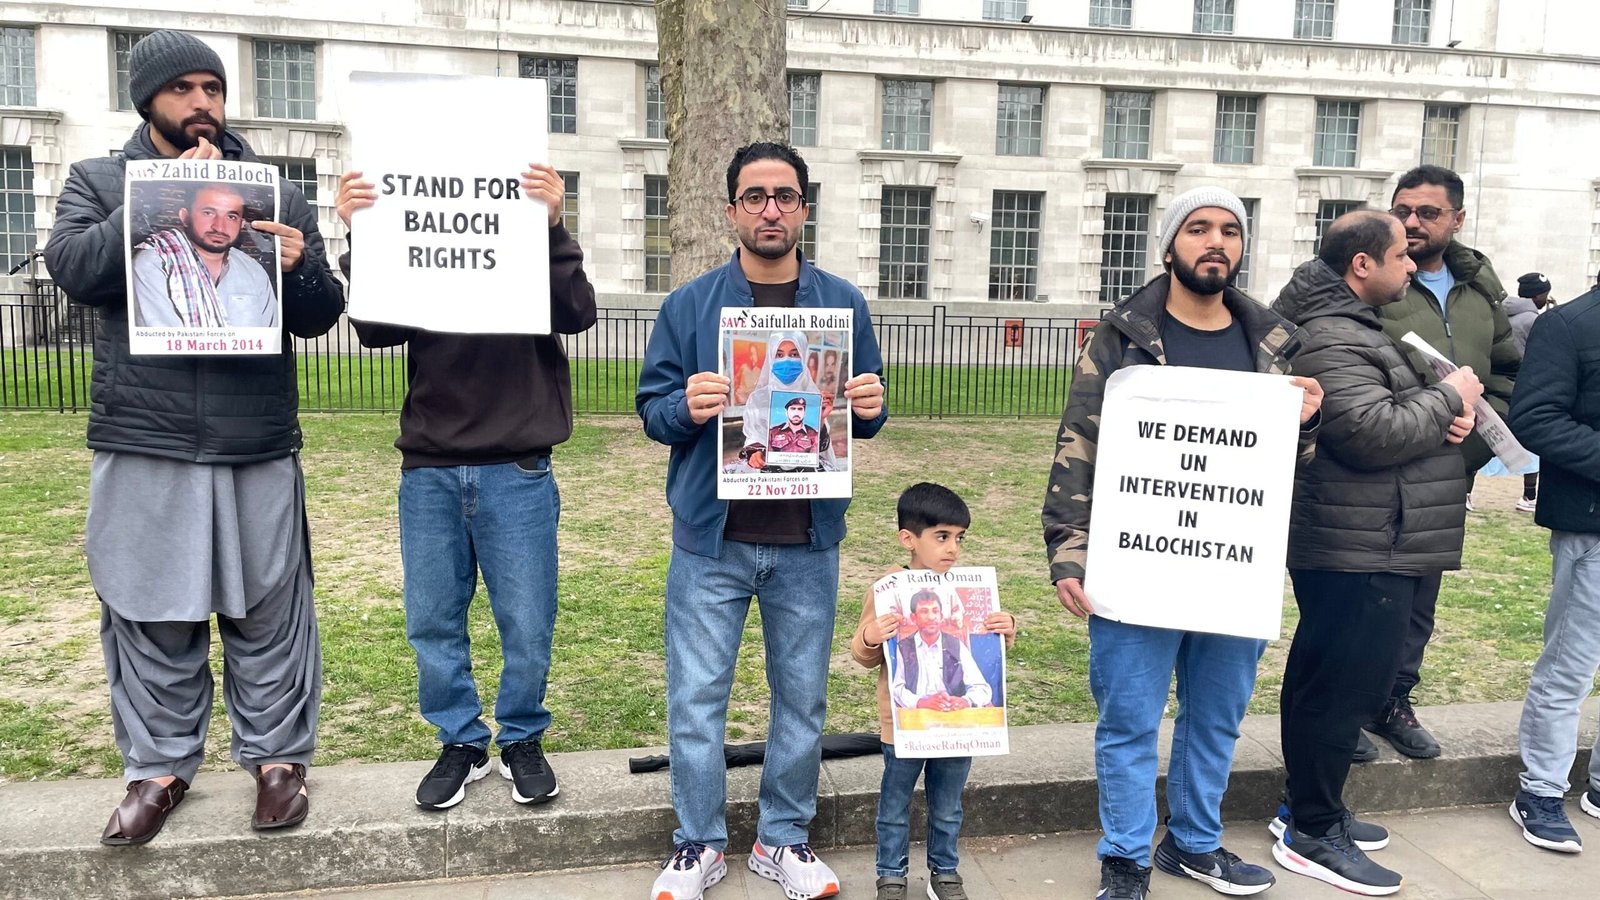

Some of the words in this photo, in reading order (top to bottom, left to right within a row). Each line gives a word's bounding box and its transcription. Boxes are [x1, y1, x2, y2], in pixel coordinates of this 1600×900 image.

[162, 162, 209, 179] Zahid
[216, 164, 273, 184] Baloch
[382, 173, 464, 198] STAND
[474, 178, 520, 200] FOR
[404, 210, 500, 235] BALOCH
[408, 246, 497, 270] RIGHTS
[750, 314, 806, 328] Saifullah
[811, 314, 850, 328] Rodini
[166, 339, 182, 351] 18
[187, 339, 228, 350] March
[231, 339, 264, 350] 2014
[1138, 420, 1167, 440] WE
[1174, 424, 1258, 448] DEMAND
[1180, 454, 1208, 472] UN
[748, 484, 762, 496] 22
[766, 484, 787, 496] Nov
[790, 484, 818, 496] 2013
[1119, 475, 1264, 507] INTERVENTION
[1178, 510, 1198, 528] IN
[1118, 532, 1254, 564] BALOCHISTAN
[907, 572, 941, 585] Rafiq
[944, 572, 982, 582] Oman
